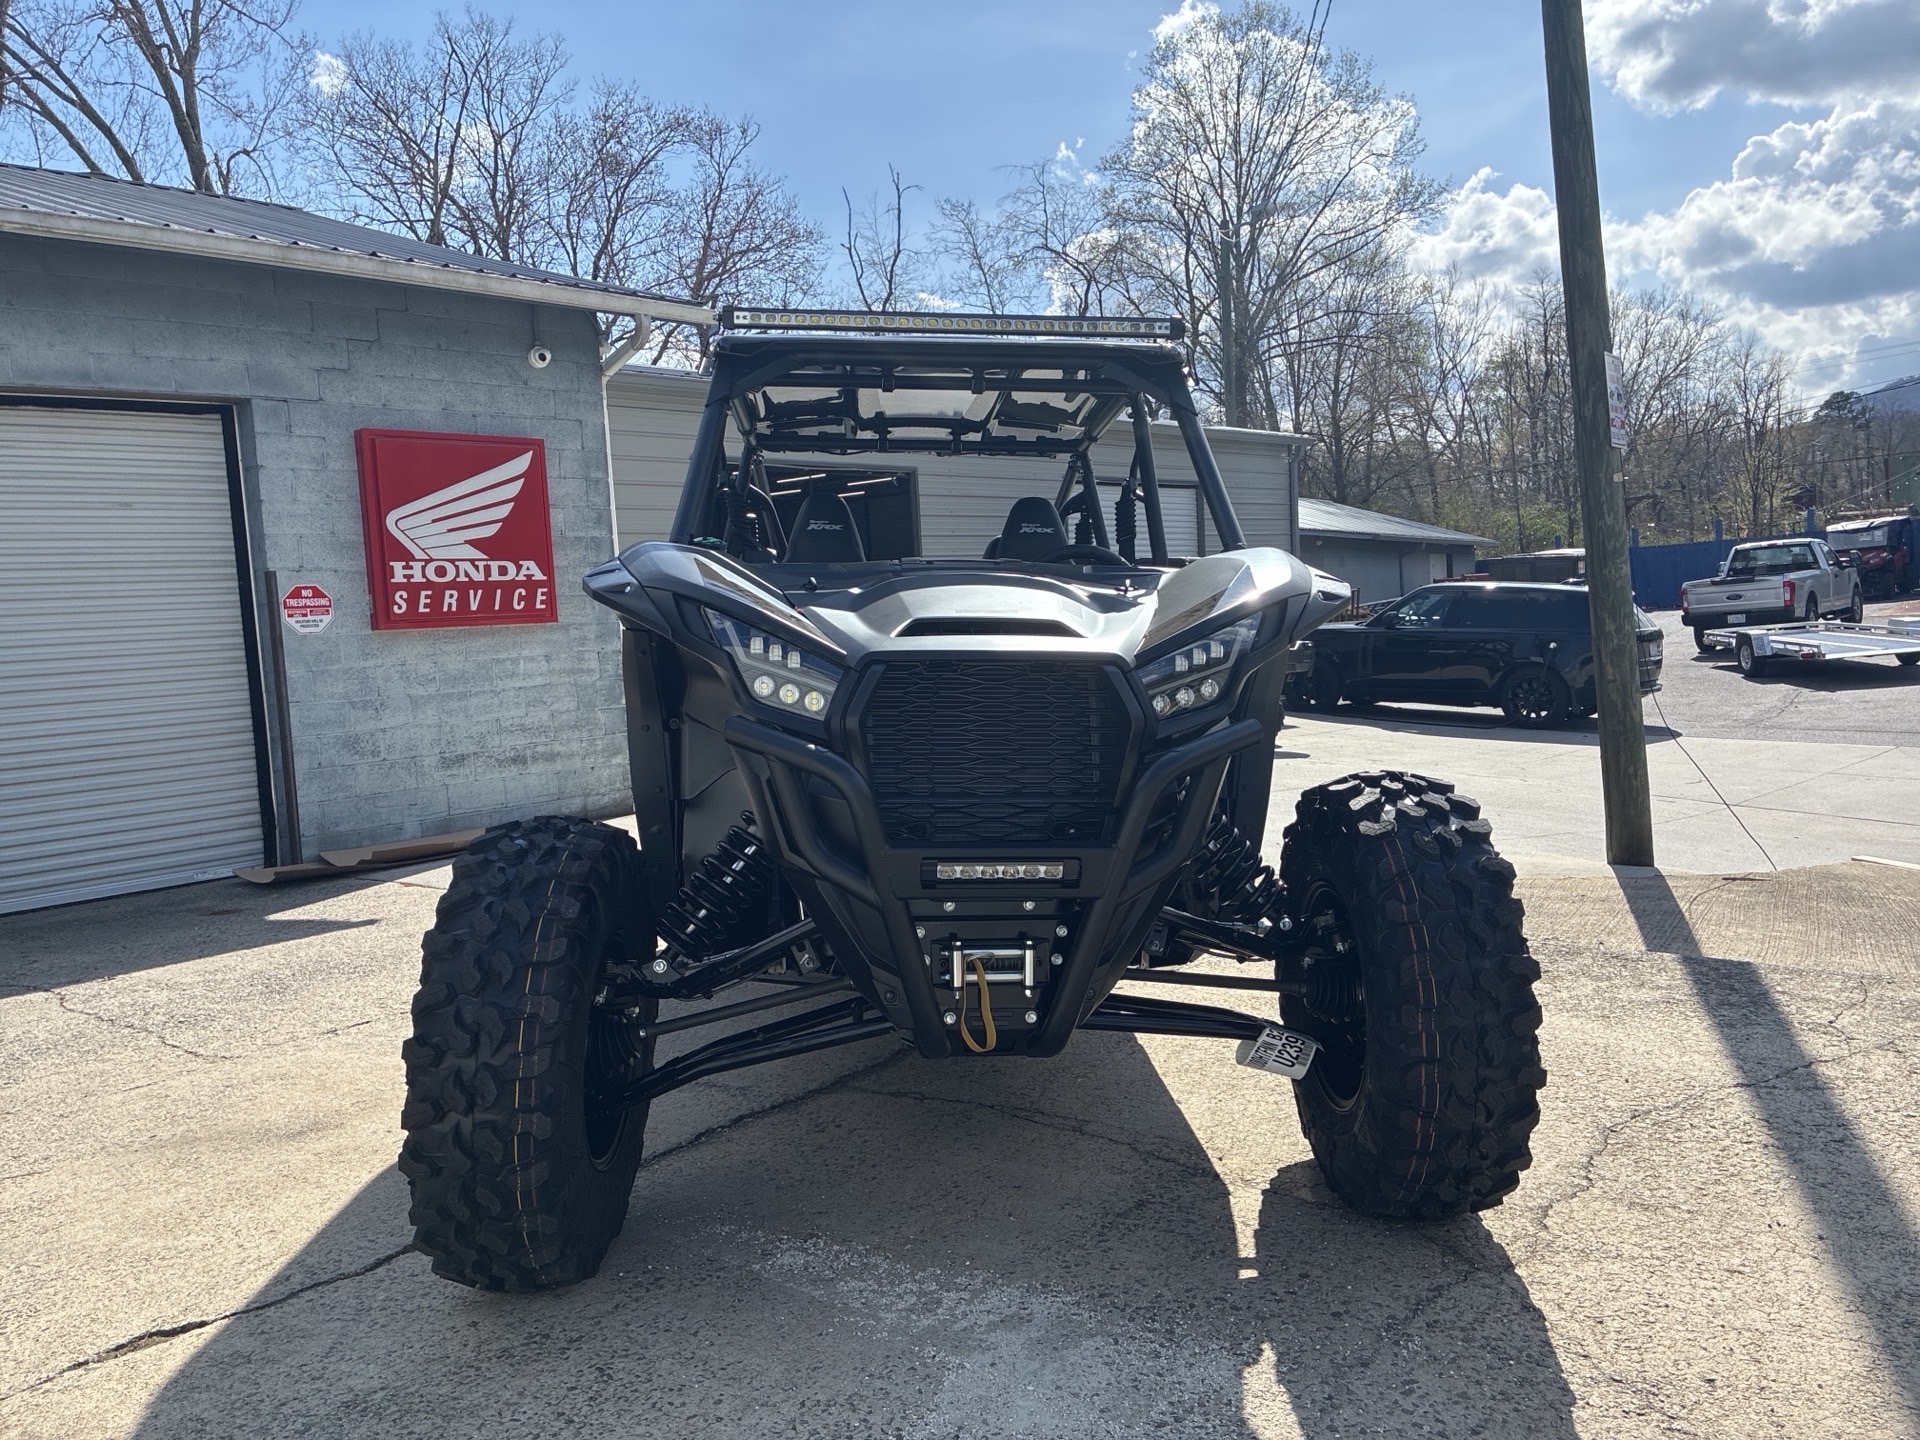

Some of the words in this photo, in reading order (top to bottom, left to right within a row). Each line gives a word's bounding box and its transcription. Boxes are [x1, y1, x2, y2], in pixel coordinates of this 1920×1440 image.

[389, 560, 548, 583] HONDA
[301, 589, 313, 597] NO
[392, 588, 548, 614] SERVICE
[285, 598, 330, 607] TRESPASSING
